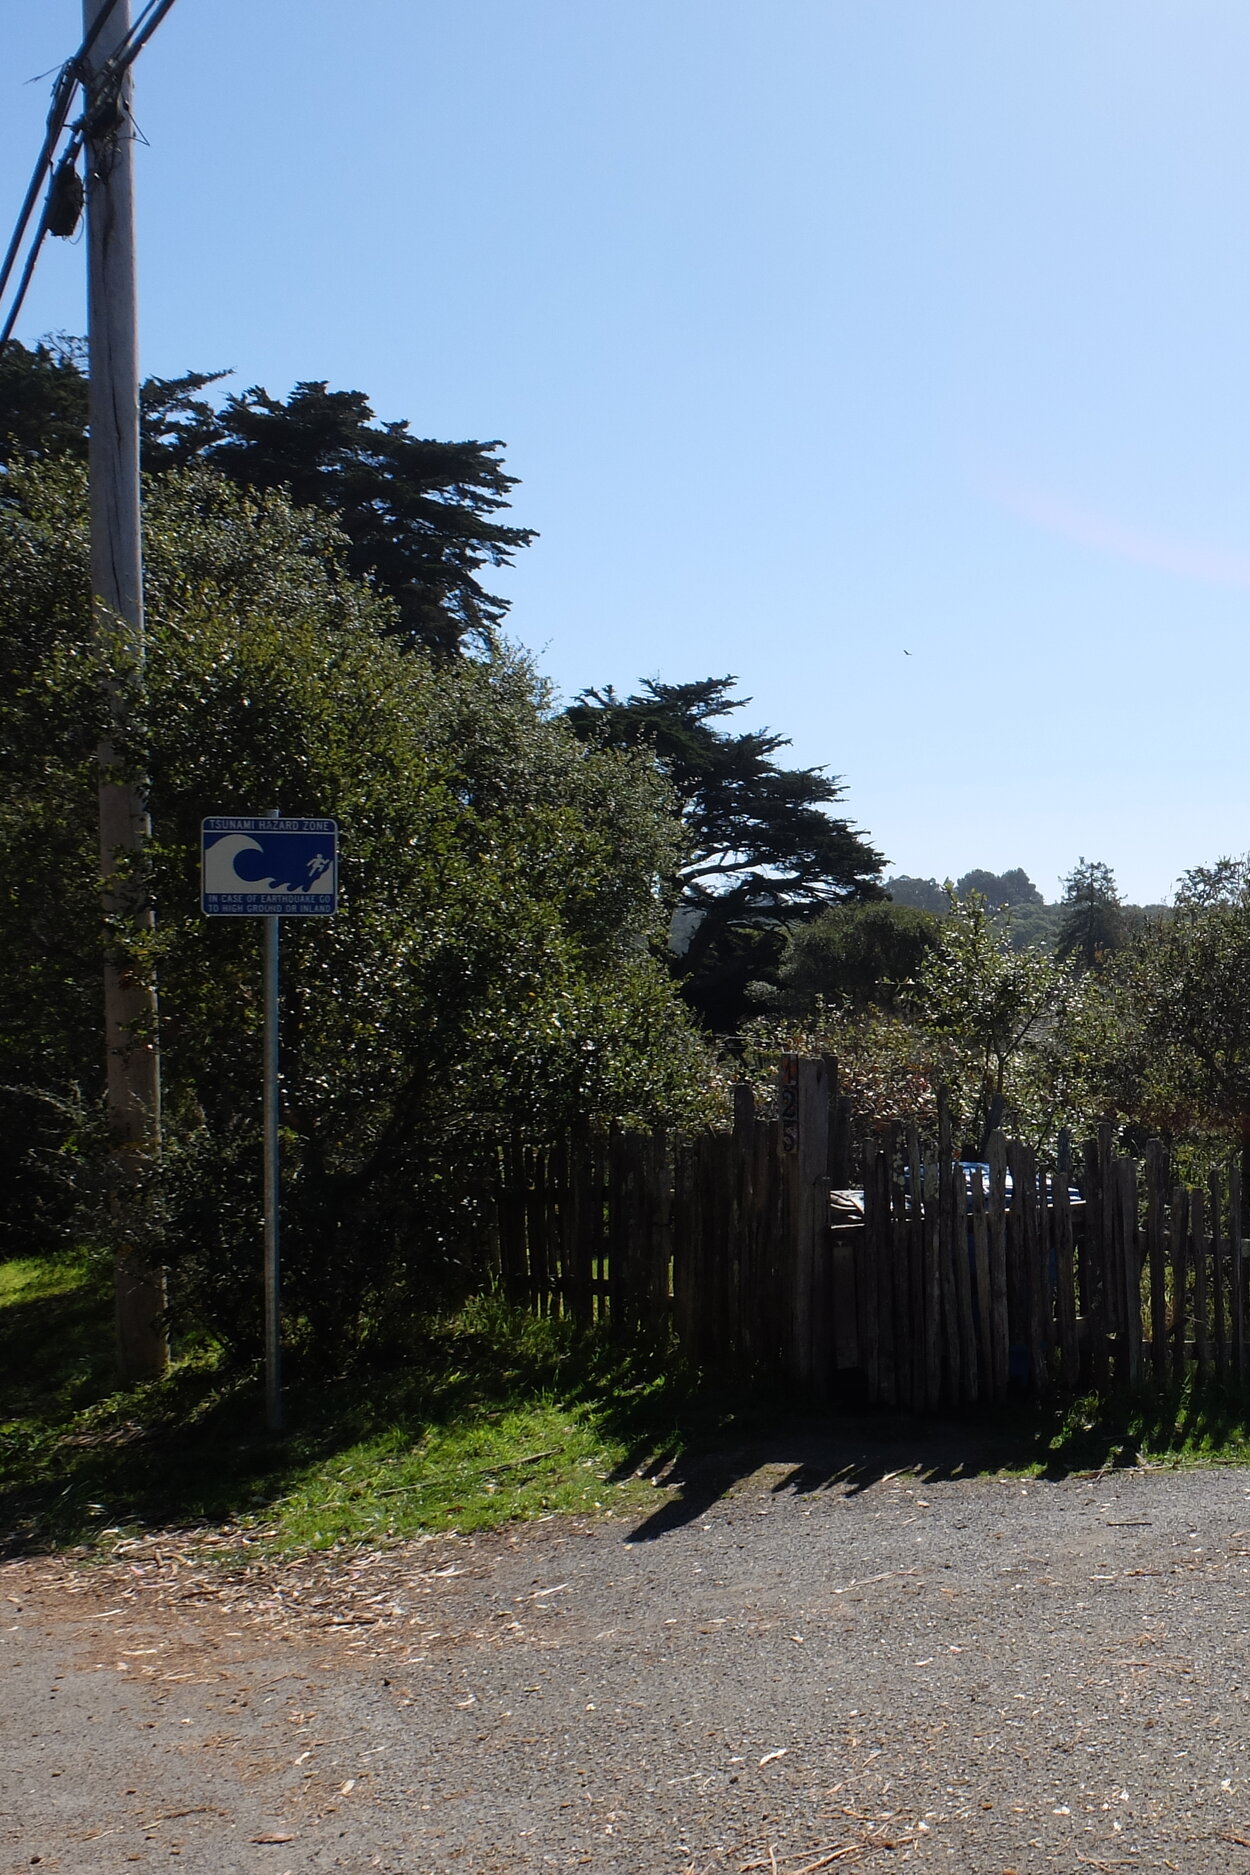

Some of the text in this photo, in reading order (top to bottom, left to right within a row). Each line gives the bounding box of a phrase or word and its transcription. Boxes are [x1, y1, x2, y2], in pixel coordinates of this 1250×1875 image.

[209, 819, 329, 831] TSUNAMI HAZARD ZONE
[208, 894, 330, 903] IN CASE OF EARTHQUAKE GO
[208, 904, 330, 913] TO HIGH GROUND OR INLAND
